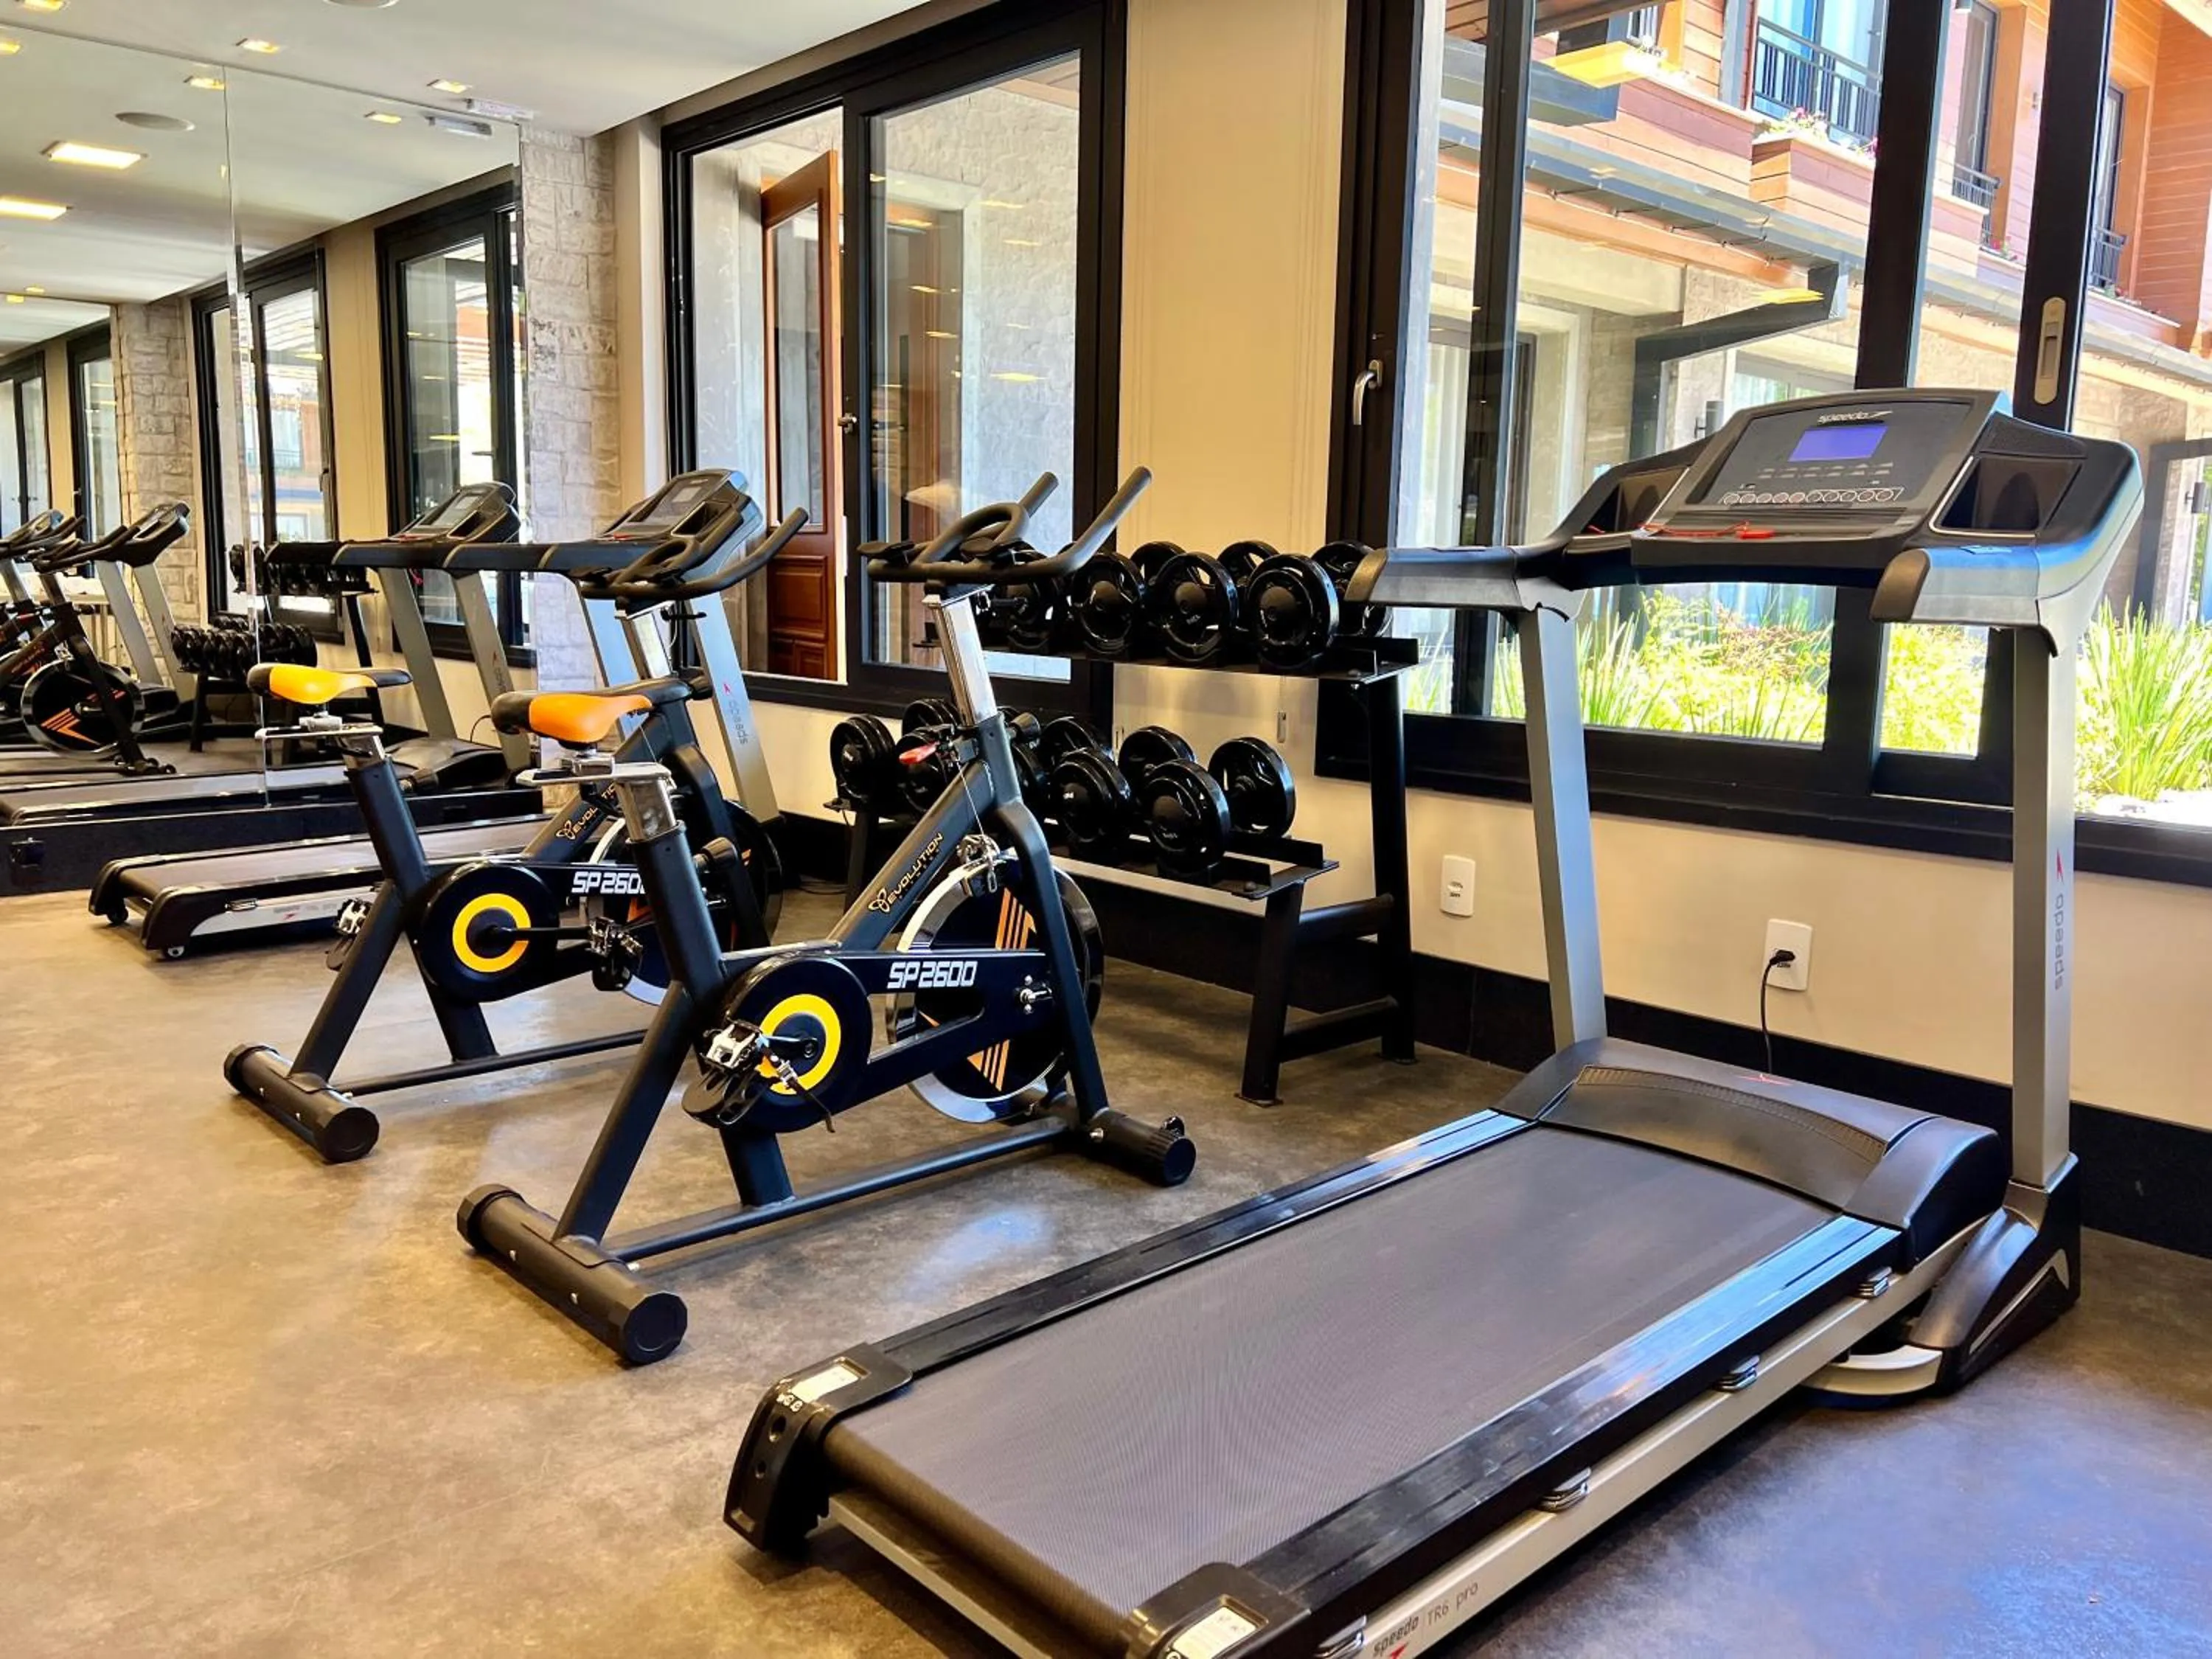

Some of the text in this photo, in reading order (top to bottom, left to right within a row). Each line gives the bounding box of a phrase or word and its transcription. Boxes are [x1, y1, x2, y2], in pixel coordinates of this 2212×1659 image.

[571, 870, 646, 894] SP260
[887, 832, 943, 905] EVOLUTION
[887, 961, 978, 989] SP2600
[2054, 893, 2065, 990] speedo
[1372, 1582, 1479, 1658] speedo TR6 pro
